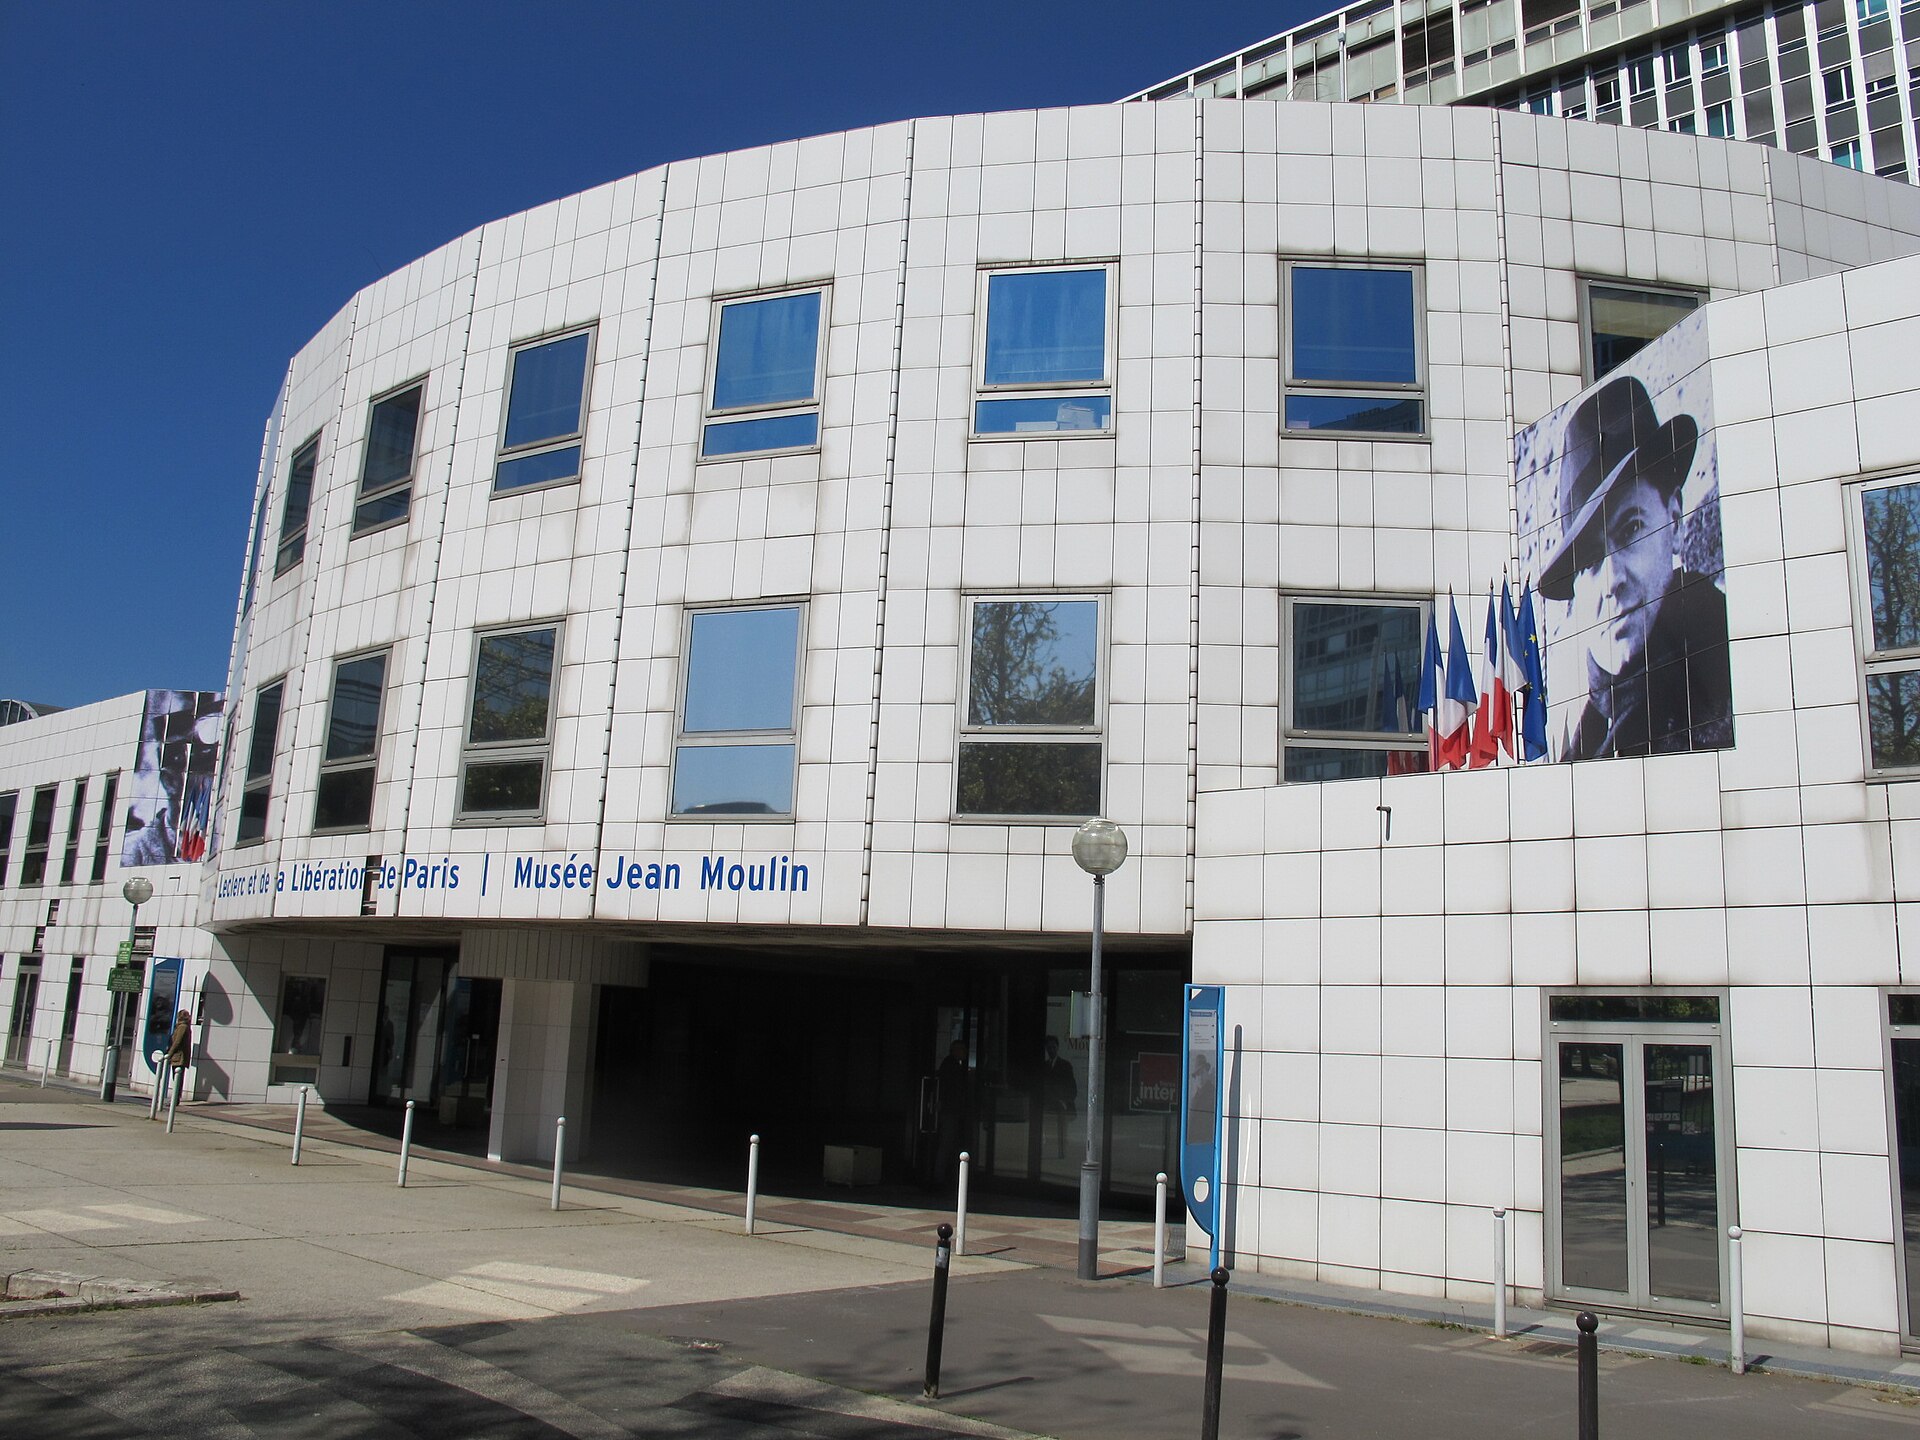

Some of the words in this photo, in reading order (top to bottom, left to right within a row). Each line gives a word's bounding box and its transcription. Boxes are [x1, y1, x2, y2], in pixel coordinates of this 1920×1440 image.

[218, 873, 246, 898] Leclerc
[247, 868, 258, 895] et
[259, 867, 270, 893] de
[403, 857, 460, 889] Paris
[513, 853, 593, 889] Musée
[606, 855, 681, 890] Jean
[700, 854, 809, 892] Moulin
[1140, 1081, 1176, 1101] inter
